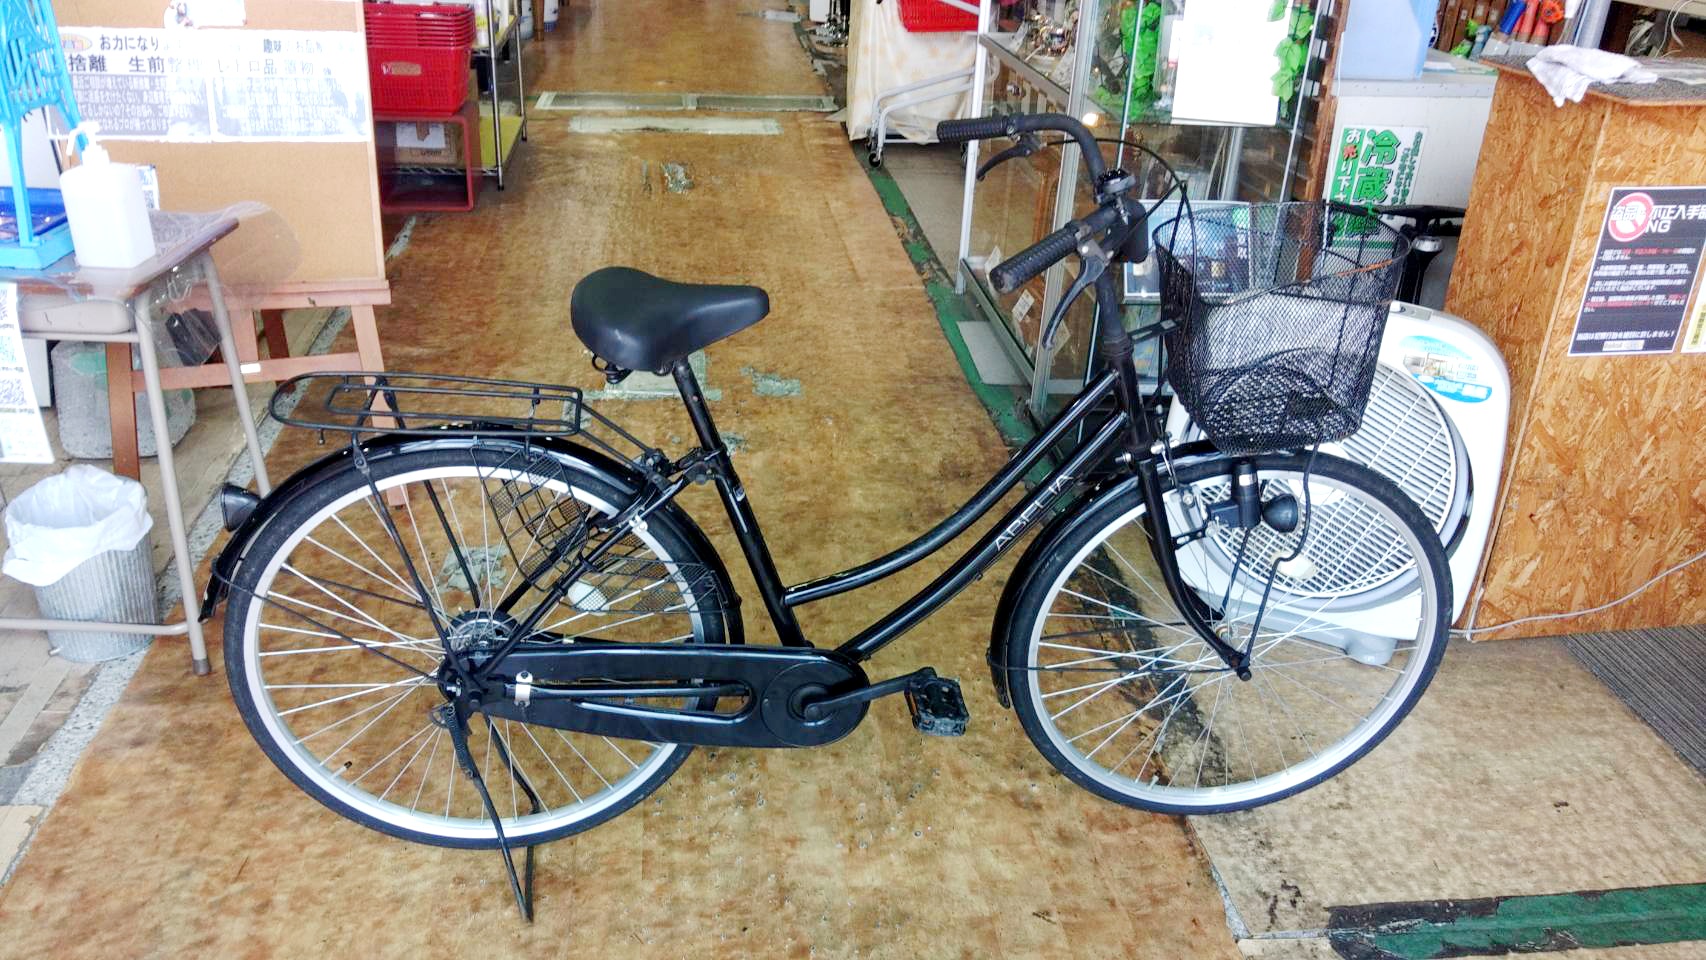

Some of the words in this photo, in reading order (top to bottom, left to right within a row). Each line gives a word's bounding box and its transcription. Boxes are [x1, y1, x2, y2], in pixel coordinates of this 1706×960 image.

[100, 34, 180, 52] お力になり
[1352, 129, 1401, 206] 冷蔵
[1645, 219, 1671, 233] NG
[994, 474, 1074, 551] ABELIA
